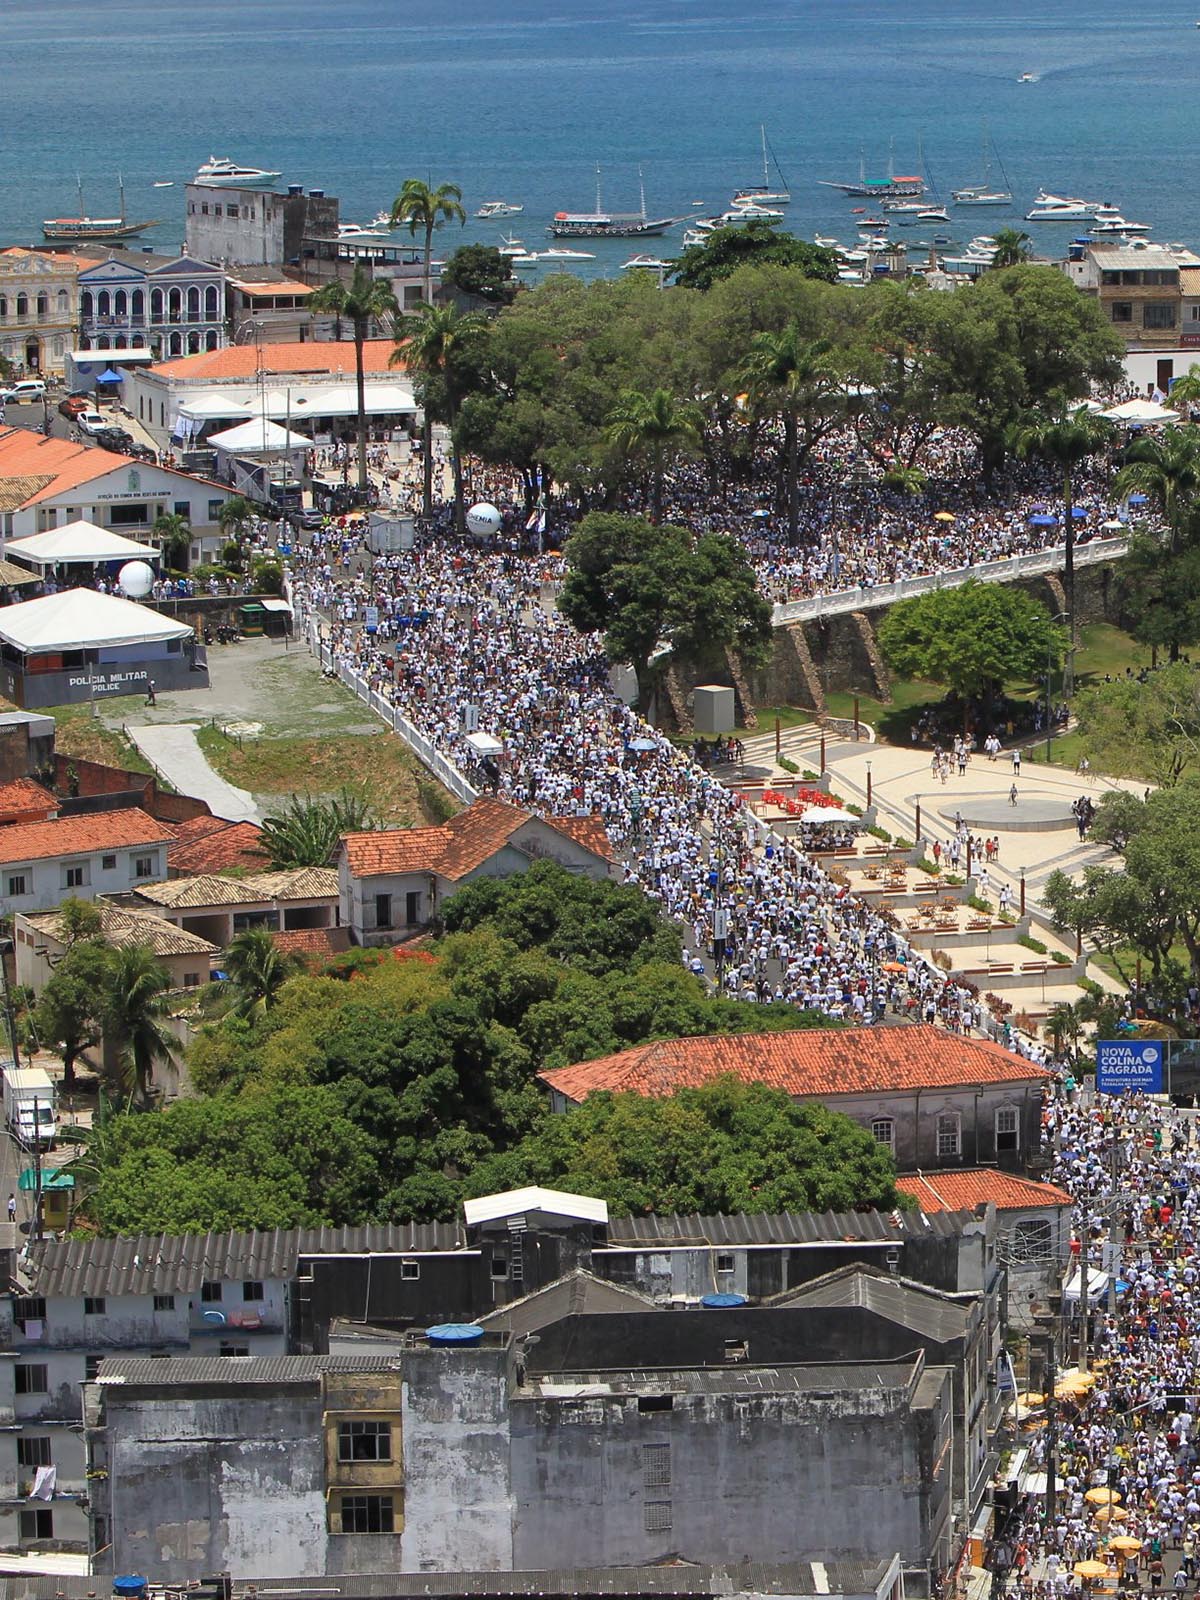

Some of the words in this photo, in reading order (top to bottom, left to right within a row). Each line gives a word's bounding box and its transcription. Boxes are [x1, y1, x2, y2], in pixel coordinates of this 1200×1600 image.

[69, 674, 106, 686] POLÍCIA
[110, 671, 147, 682] MILITAR
[92, 683, 120, 692] POLICE
[1101, 1047, 1132, 1057] NOVA
[1101, 1056, 1143, 1066] COLINA
[1101, 1065, 1153, 1075] SAGRADA
